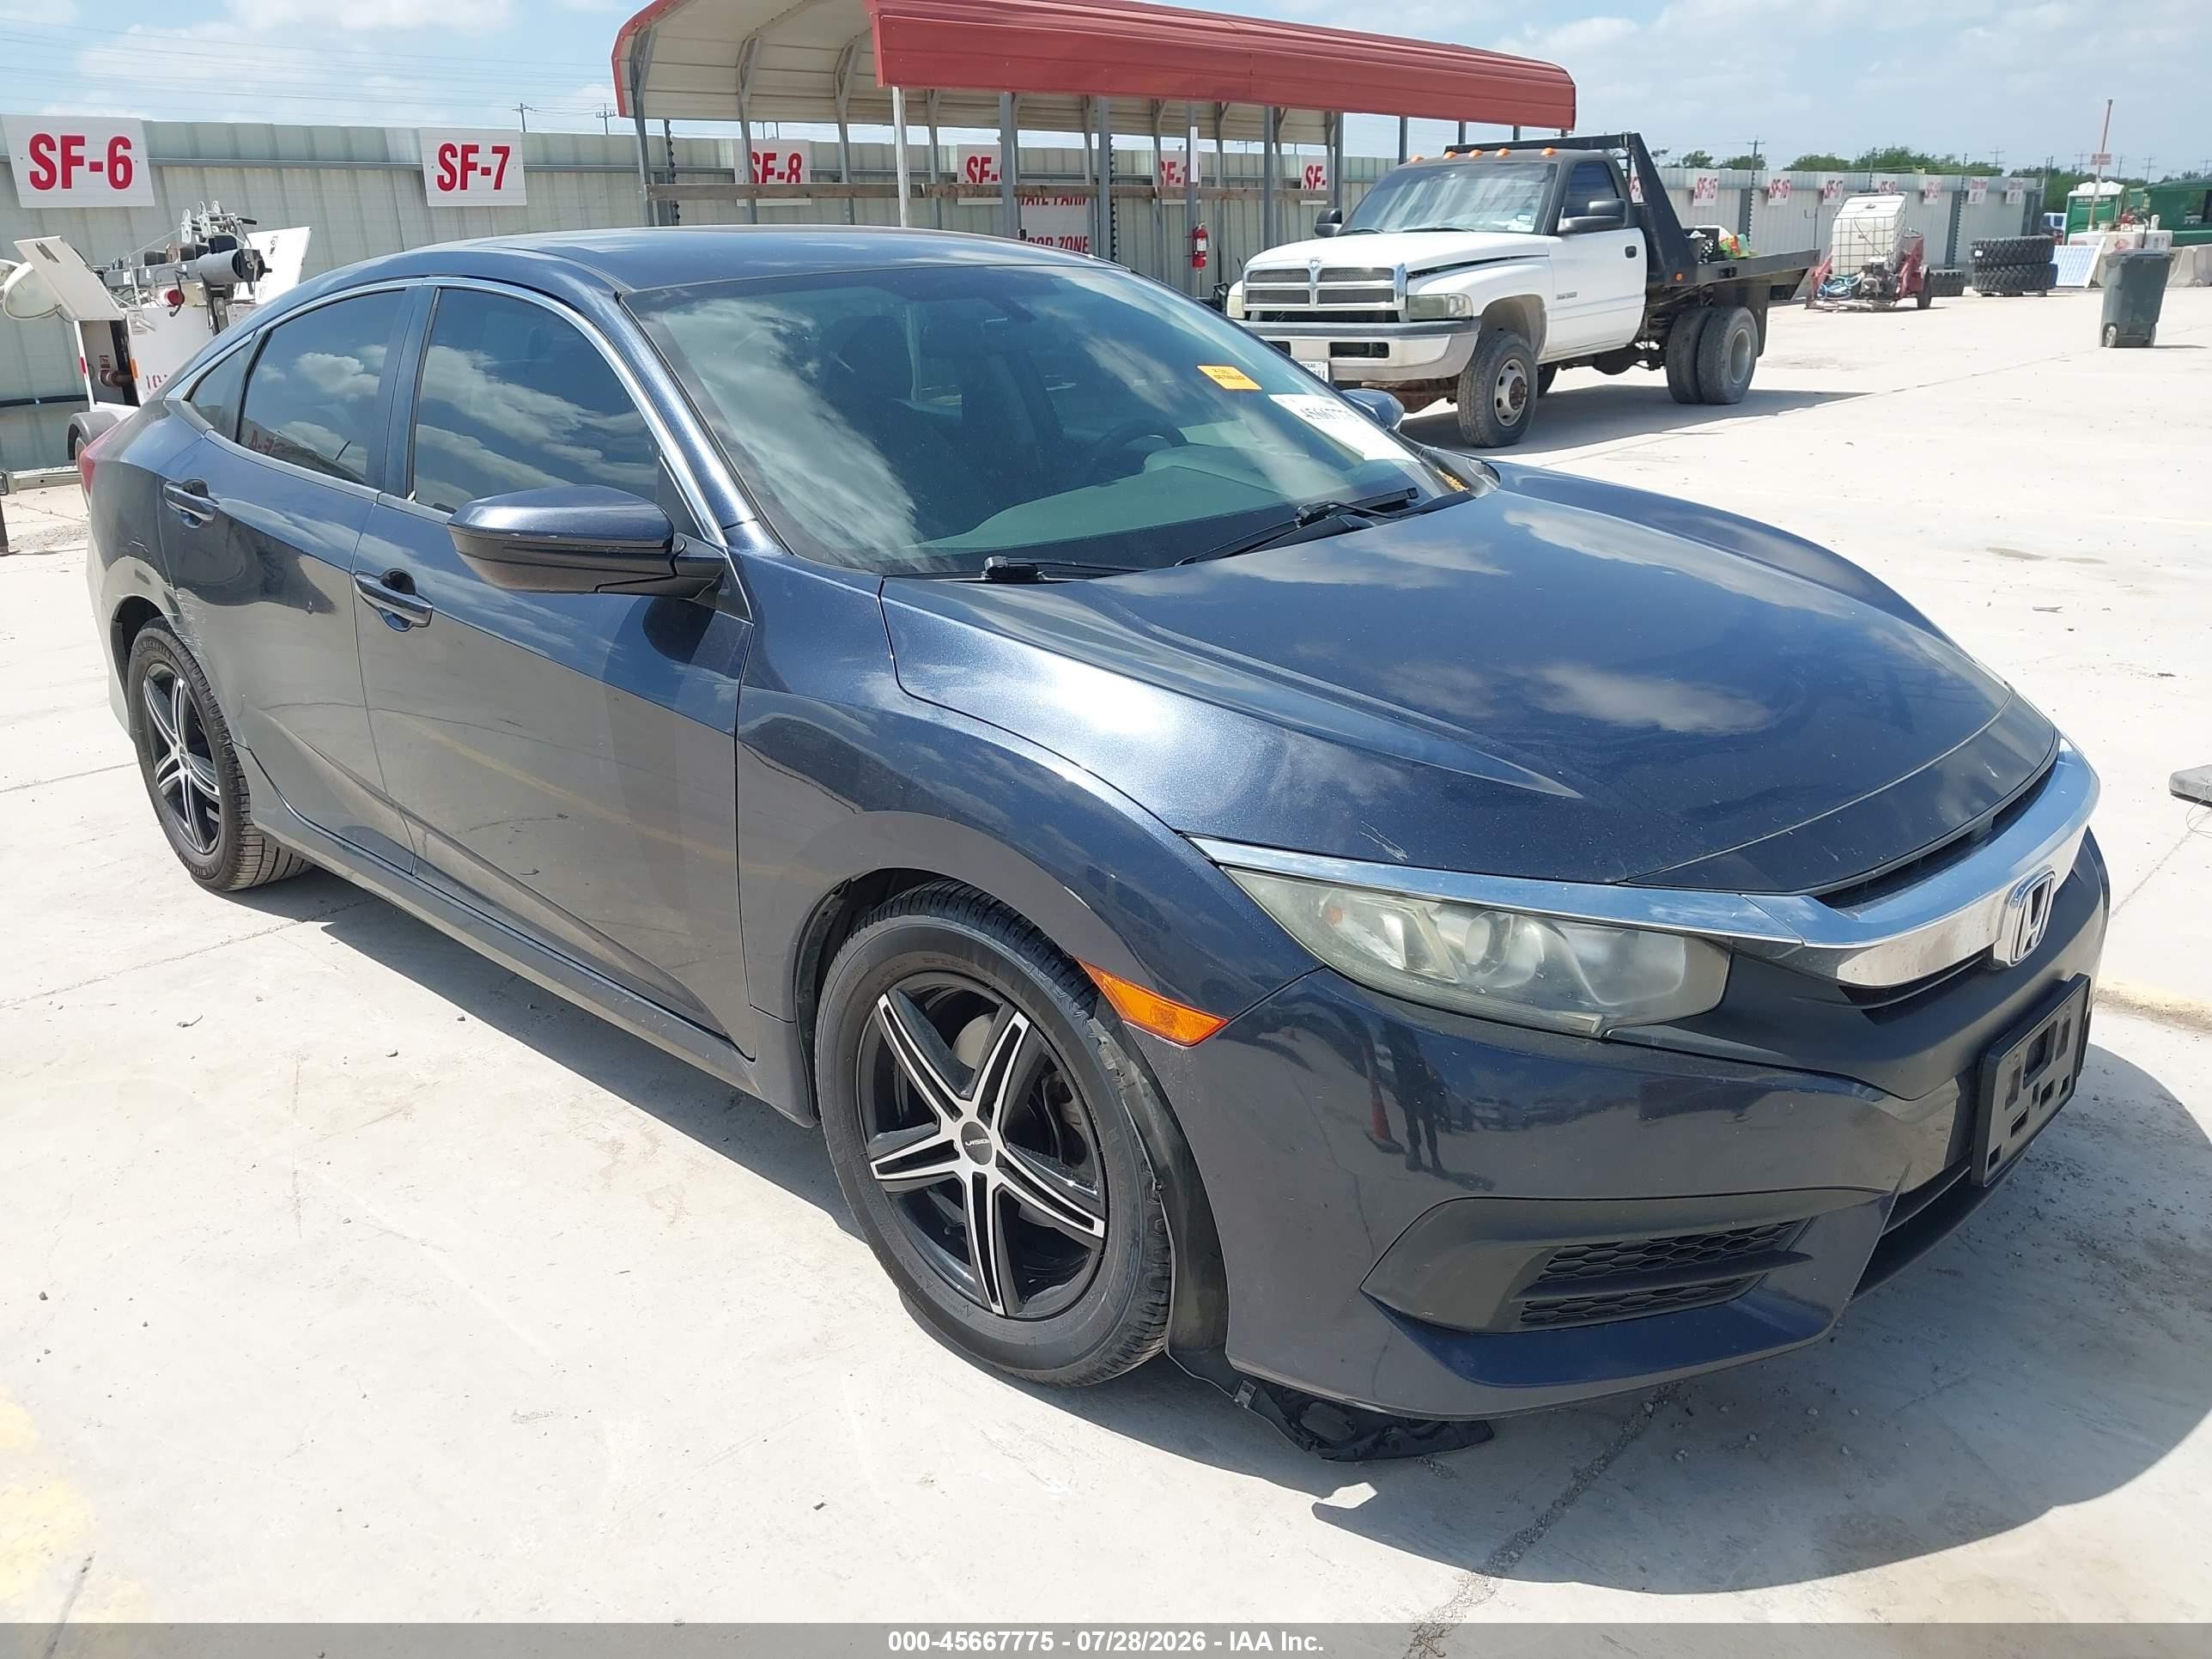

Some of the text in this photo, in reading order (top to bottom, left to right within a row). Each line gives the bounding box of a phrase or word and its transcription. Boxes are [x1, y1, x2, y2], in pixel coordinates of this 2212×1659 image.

[28, 132, 133, 191] SF-6
[436, 143, 510, 191] SF-7
[966, 155, 1002, 184] SF-
[1305, 165, 1327, 190] SF-
